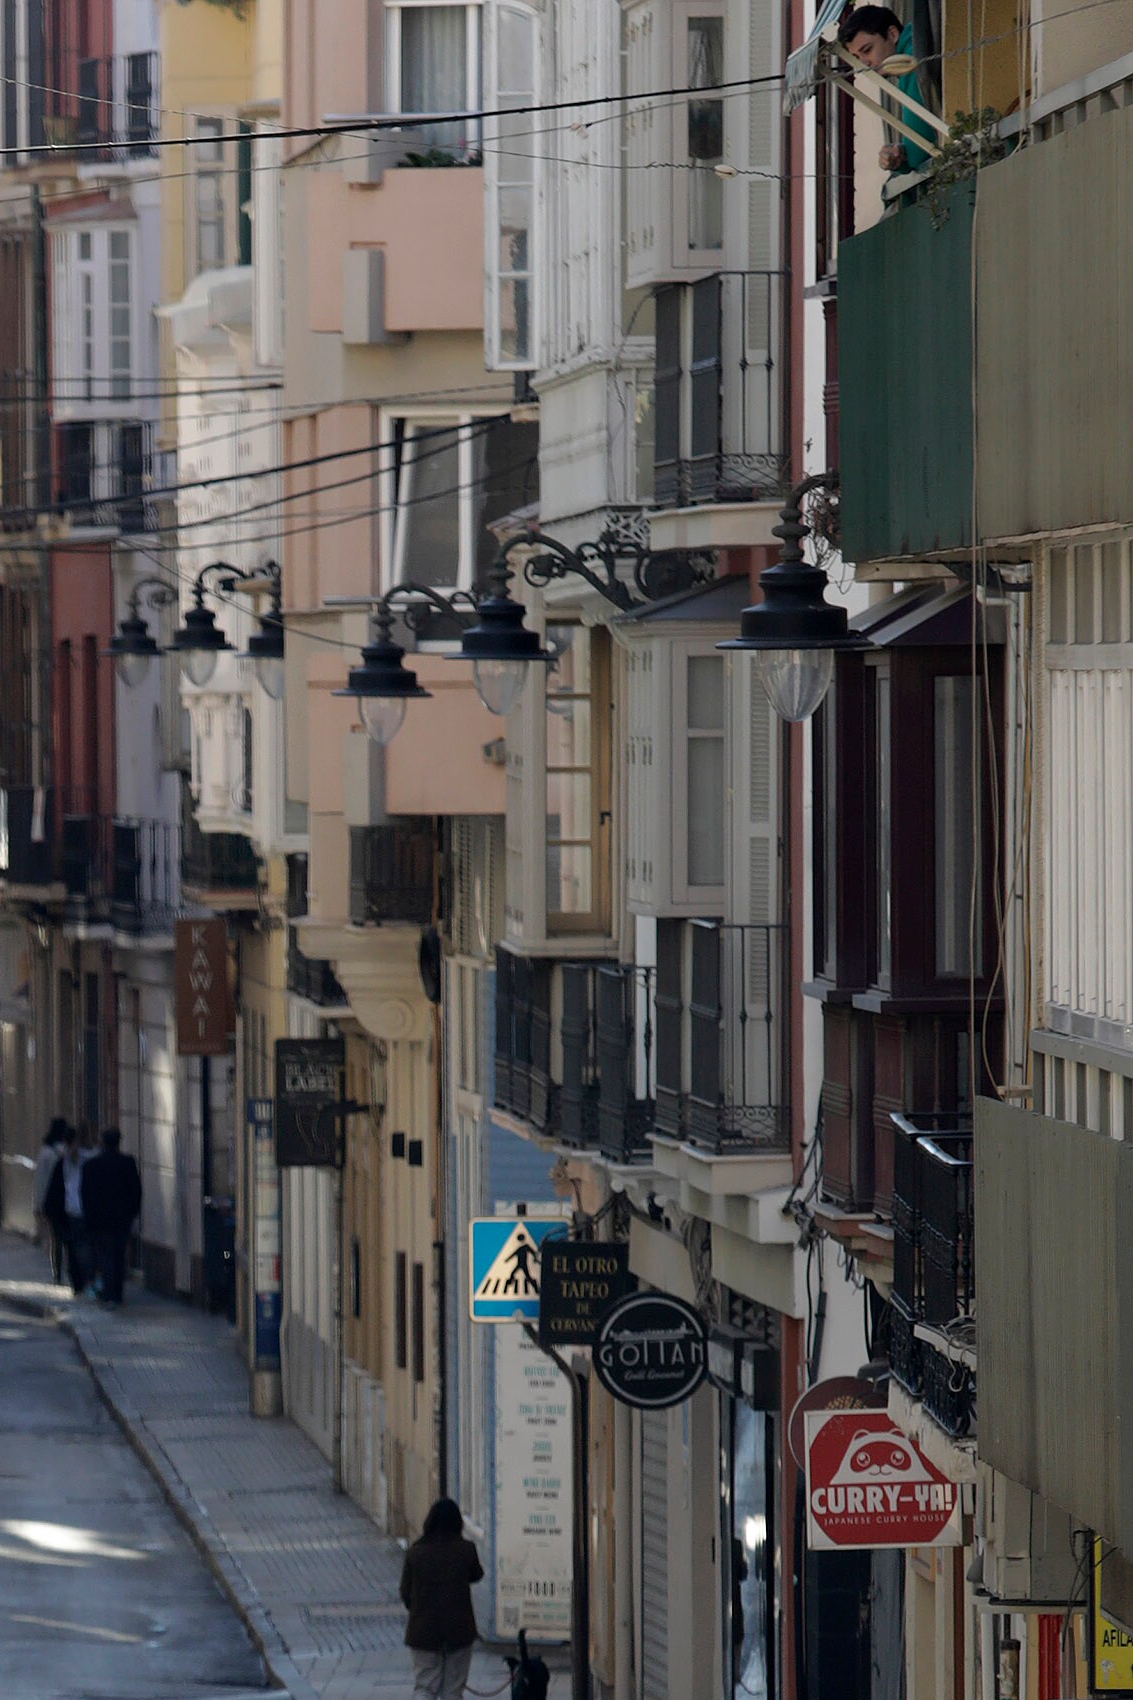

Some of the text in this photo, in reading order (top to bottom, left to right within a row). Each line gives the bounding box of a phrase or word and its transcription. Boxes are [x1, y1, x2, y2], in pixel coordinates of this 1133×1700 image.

[189, 926, 212, 1038] KAWAI
[552, 1256, 618, 1274] EL OTRO
[561, 1280, 609, 1298] TAPEO
[812, 1484, 953, 1514] CURRY-YA!
[824, 1514, 946, 1526] JAPANESE CURRY HOUSE
